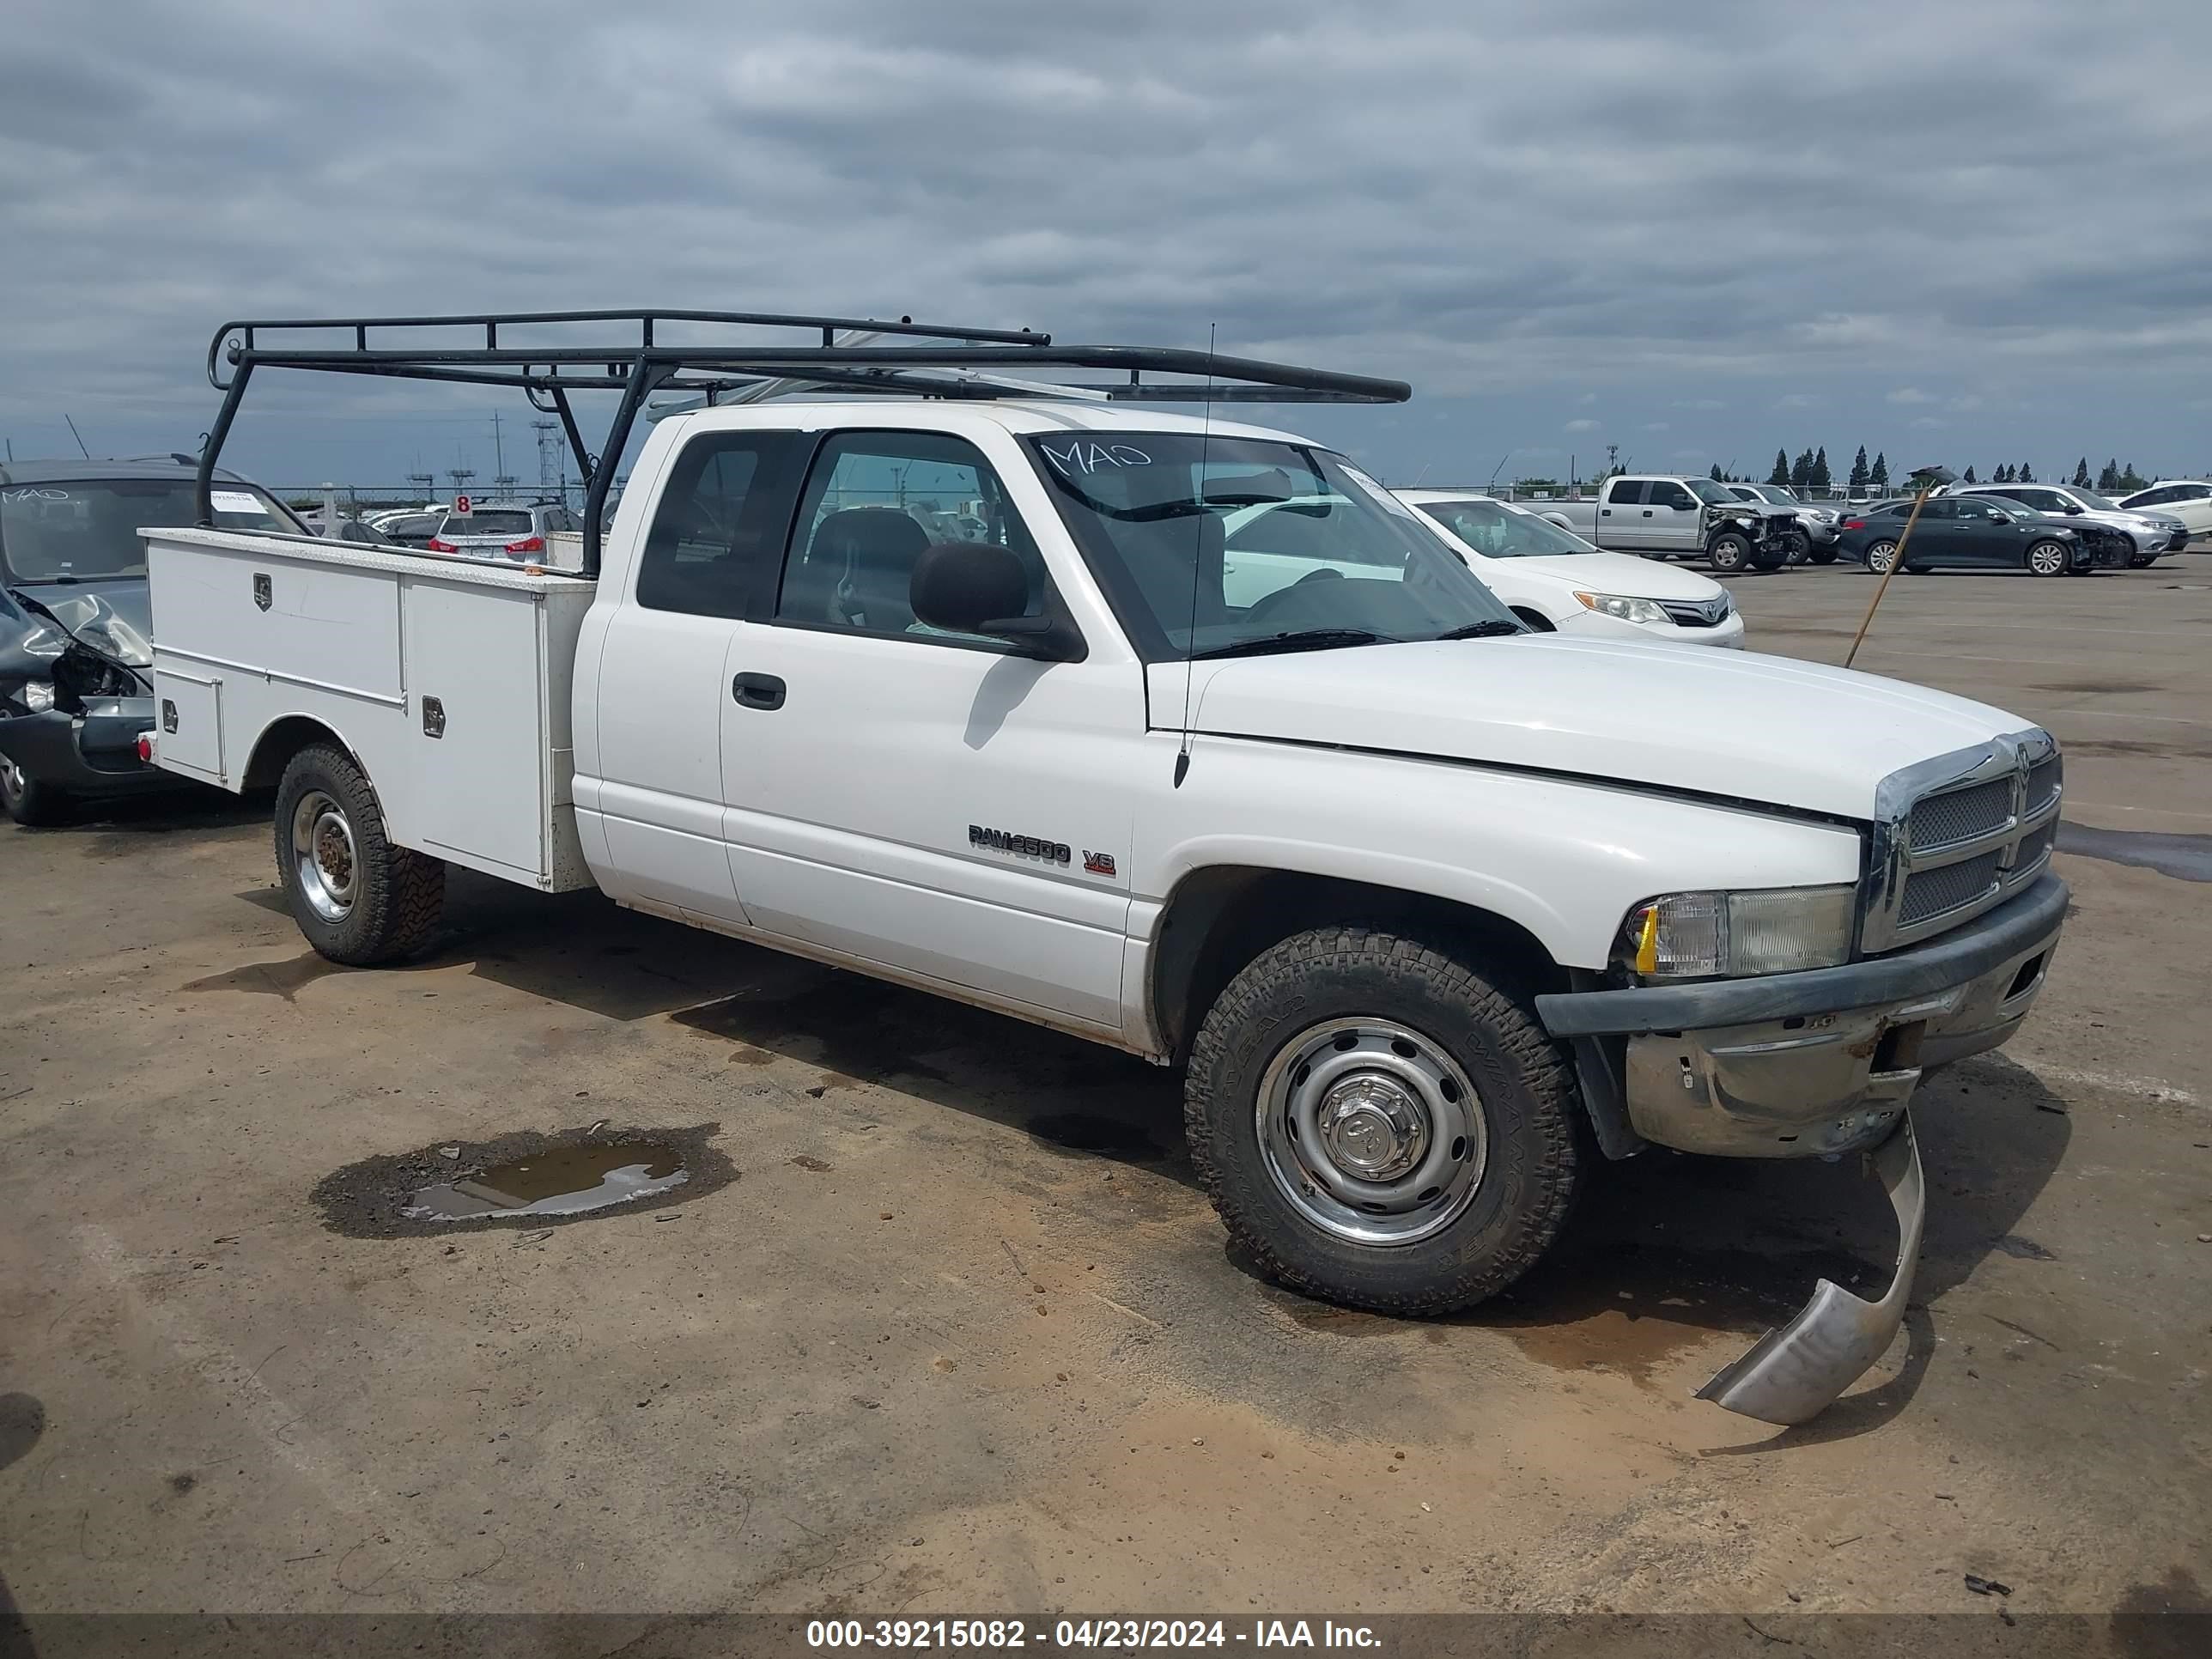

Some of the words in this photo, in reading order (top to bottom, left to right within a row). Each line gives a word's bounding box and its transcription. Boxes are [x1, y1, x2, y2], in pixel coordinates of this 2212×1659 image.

[1040, 441, 1152, 477] MAD
[2, 489, 69, 503] MAD
[457, 495, 470, 513] 8
[959, 501, 970, 514] 10
[969, 823, 1012, 849] RAM
[1012, 834, 1071, 863] 2500
[1082, 849, 1115, 869] V8
